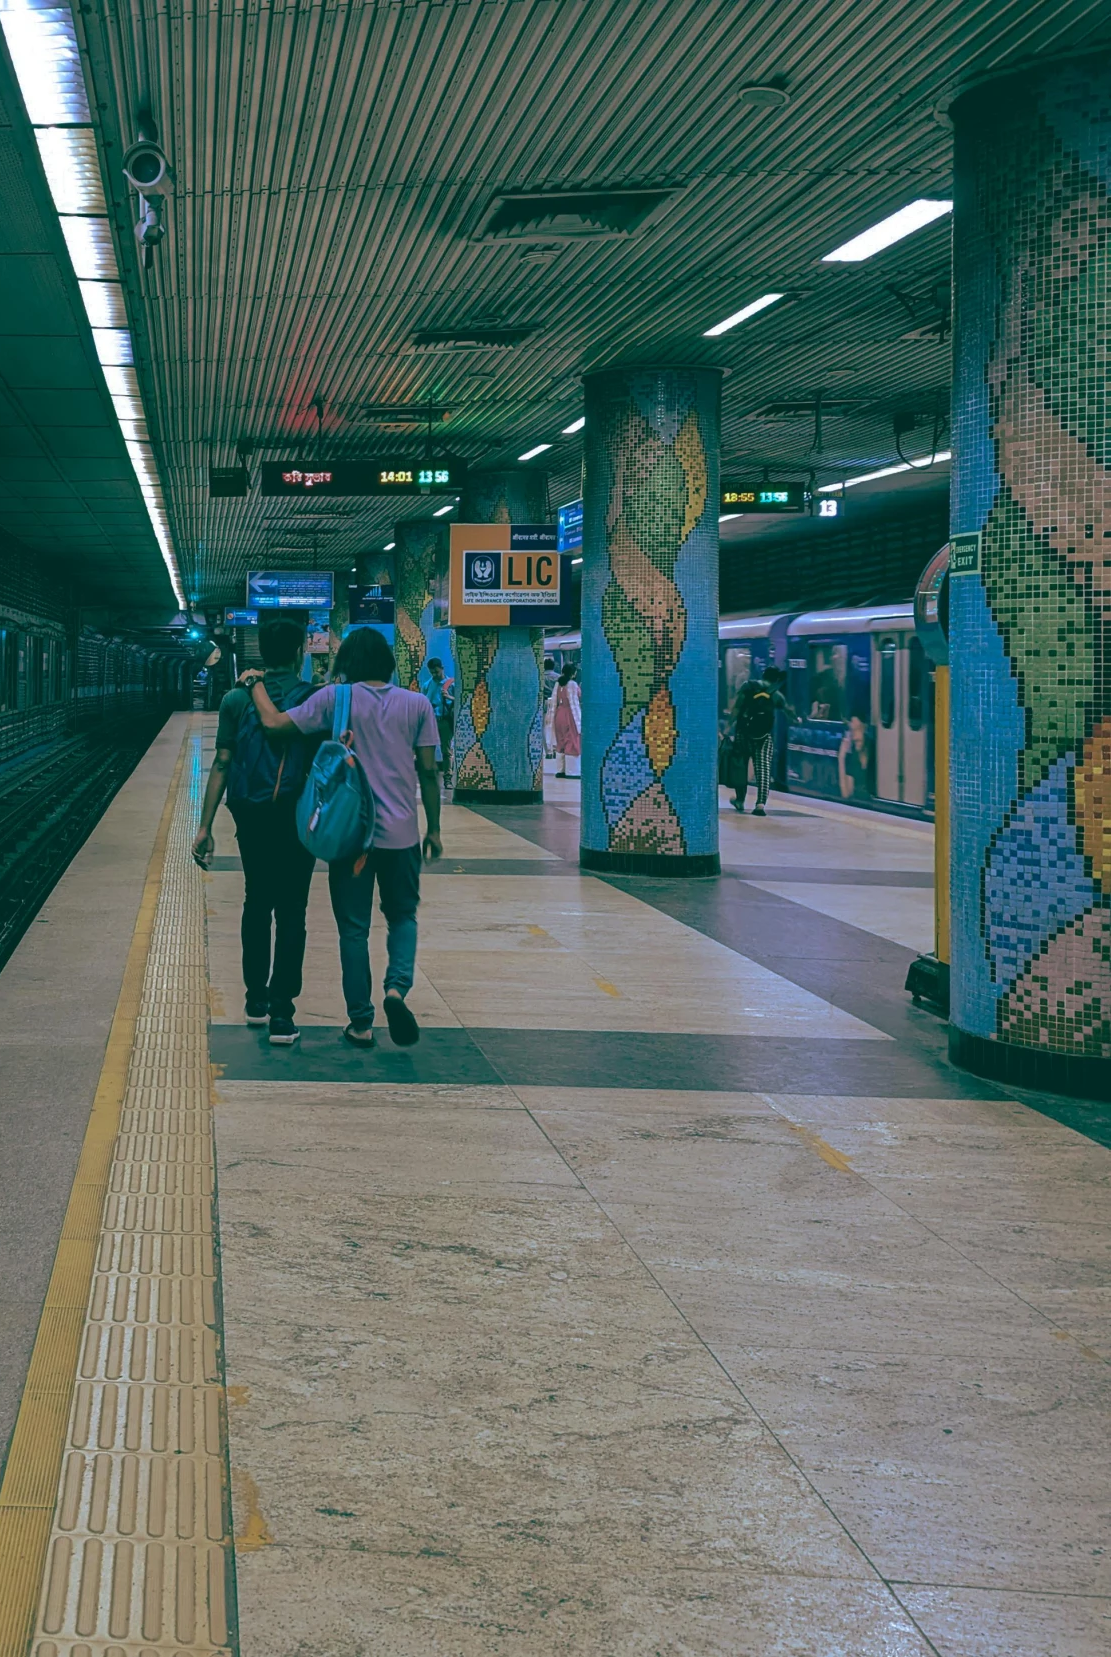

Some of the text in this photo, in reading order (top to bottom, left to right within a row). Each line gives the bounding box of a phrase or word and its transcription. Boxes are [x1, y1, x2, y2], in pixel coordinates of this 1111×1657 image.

[282, 470, 303, 483] কবি
[380, 471, 413, 482] 14:01
[723, 492, 755, 502] 18:55
[819, 500, 838, 517] 13
[957, 555, 974, 566] EXIT
[507, 556, 553, 586] LIC
